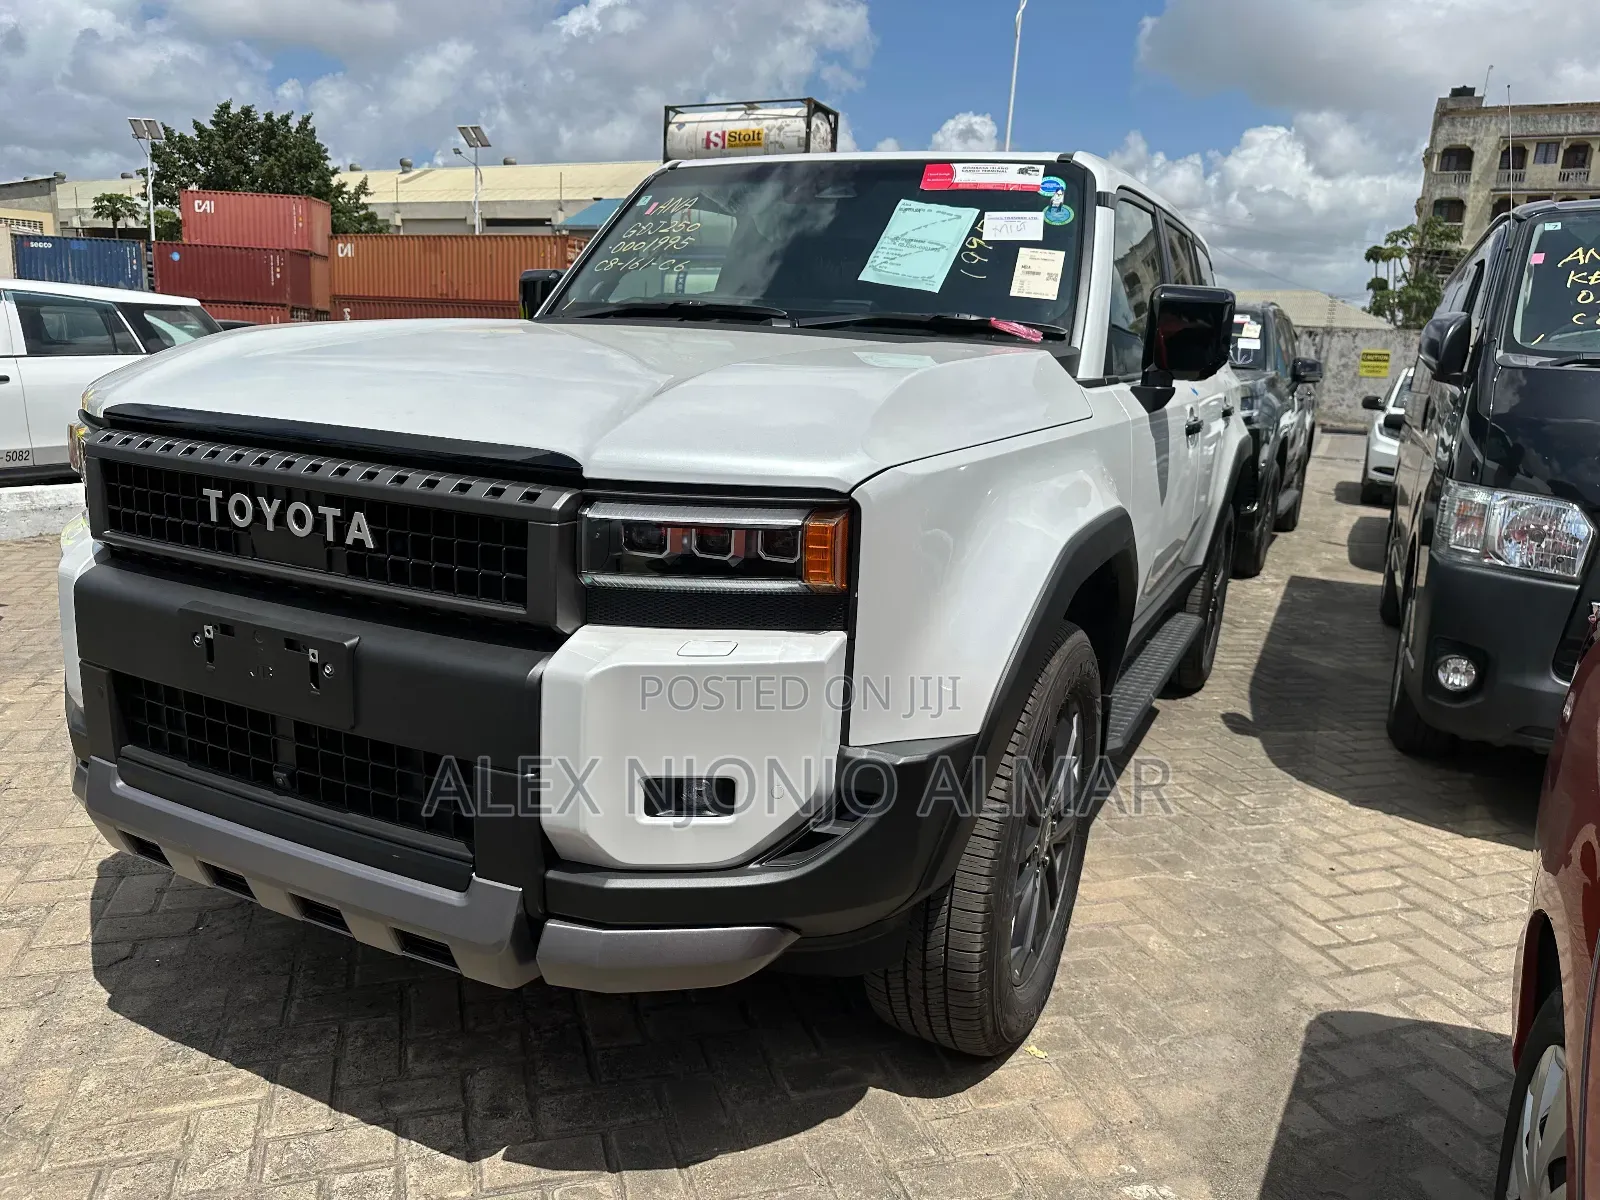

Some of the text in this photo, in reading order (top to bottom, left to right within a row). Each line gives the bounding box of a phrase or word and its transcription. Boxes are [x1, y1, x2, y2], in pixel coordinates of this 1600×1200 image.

[728, 129, 762, 143] Stolt
[194, 199, 215, 214] CAI
[202, 488, 374, 549] TOYOTA
